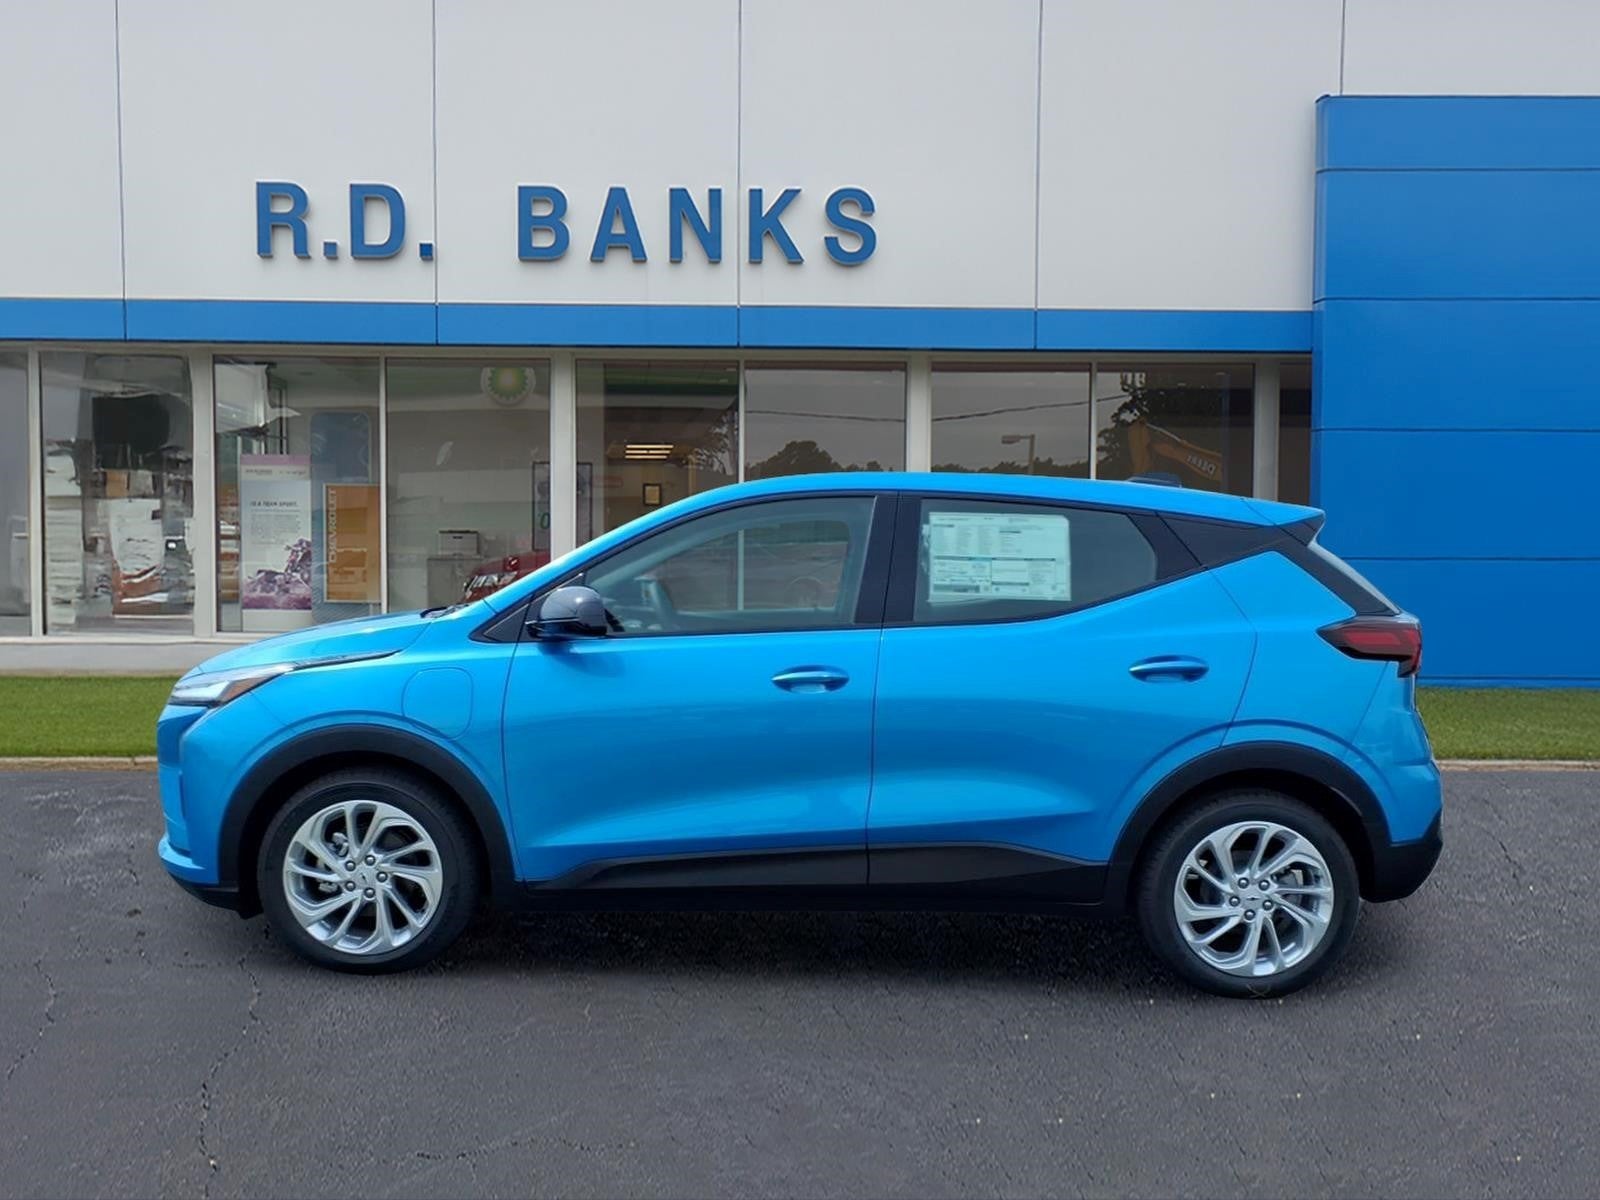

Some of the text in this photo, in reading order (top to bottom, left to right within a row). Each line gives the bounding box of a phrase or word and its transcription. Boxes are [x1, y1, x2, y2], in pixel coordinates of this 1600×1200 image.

[256, 182, 877, 265] R.D. BANKS
[327, 487, 337, 564] CHEVROLET
